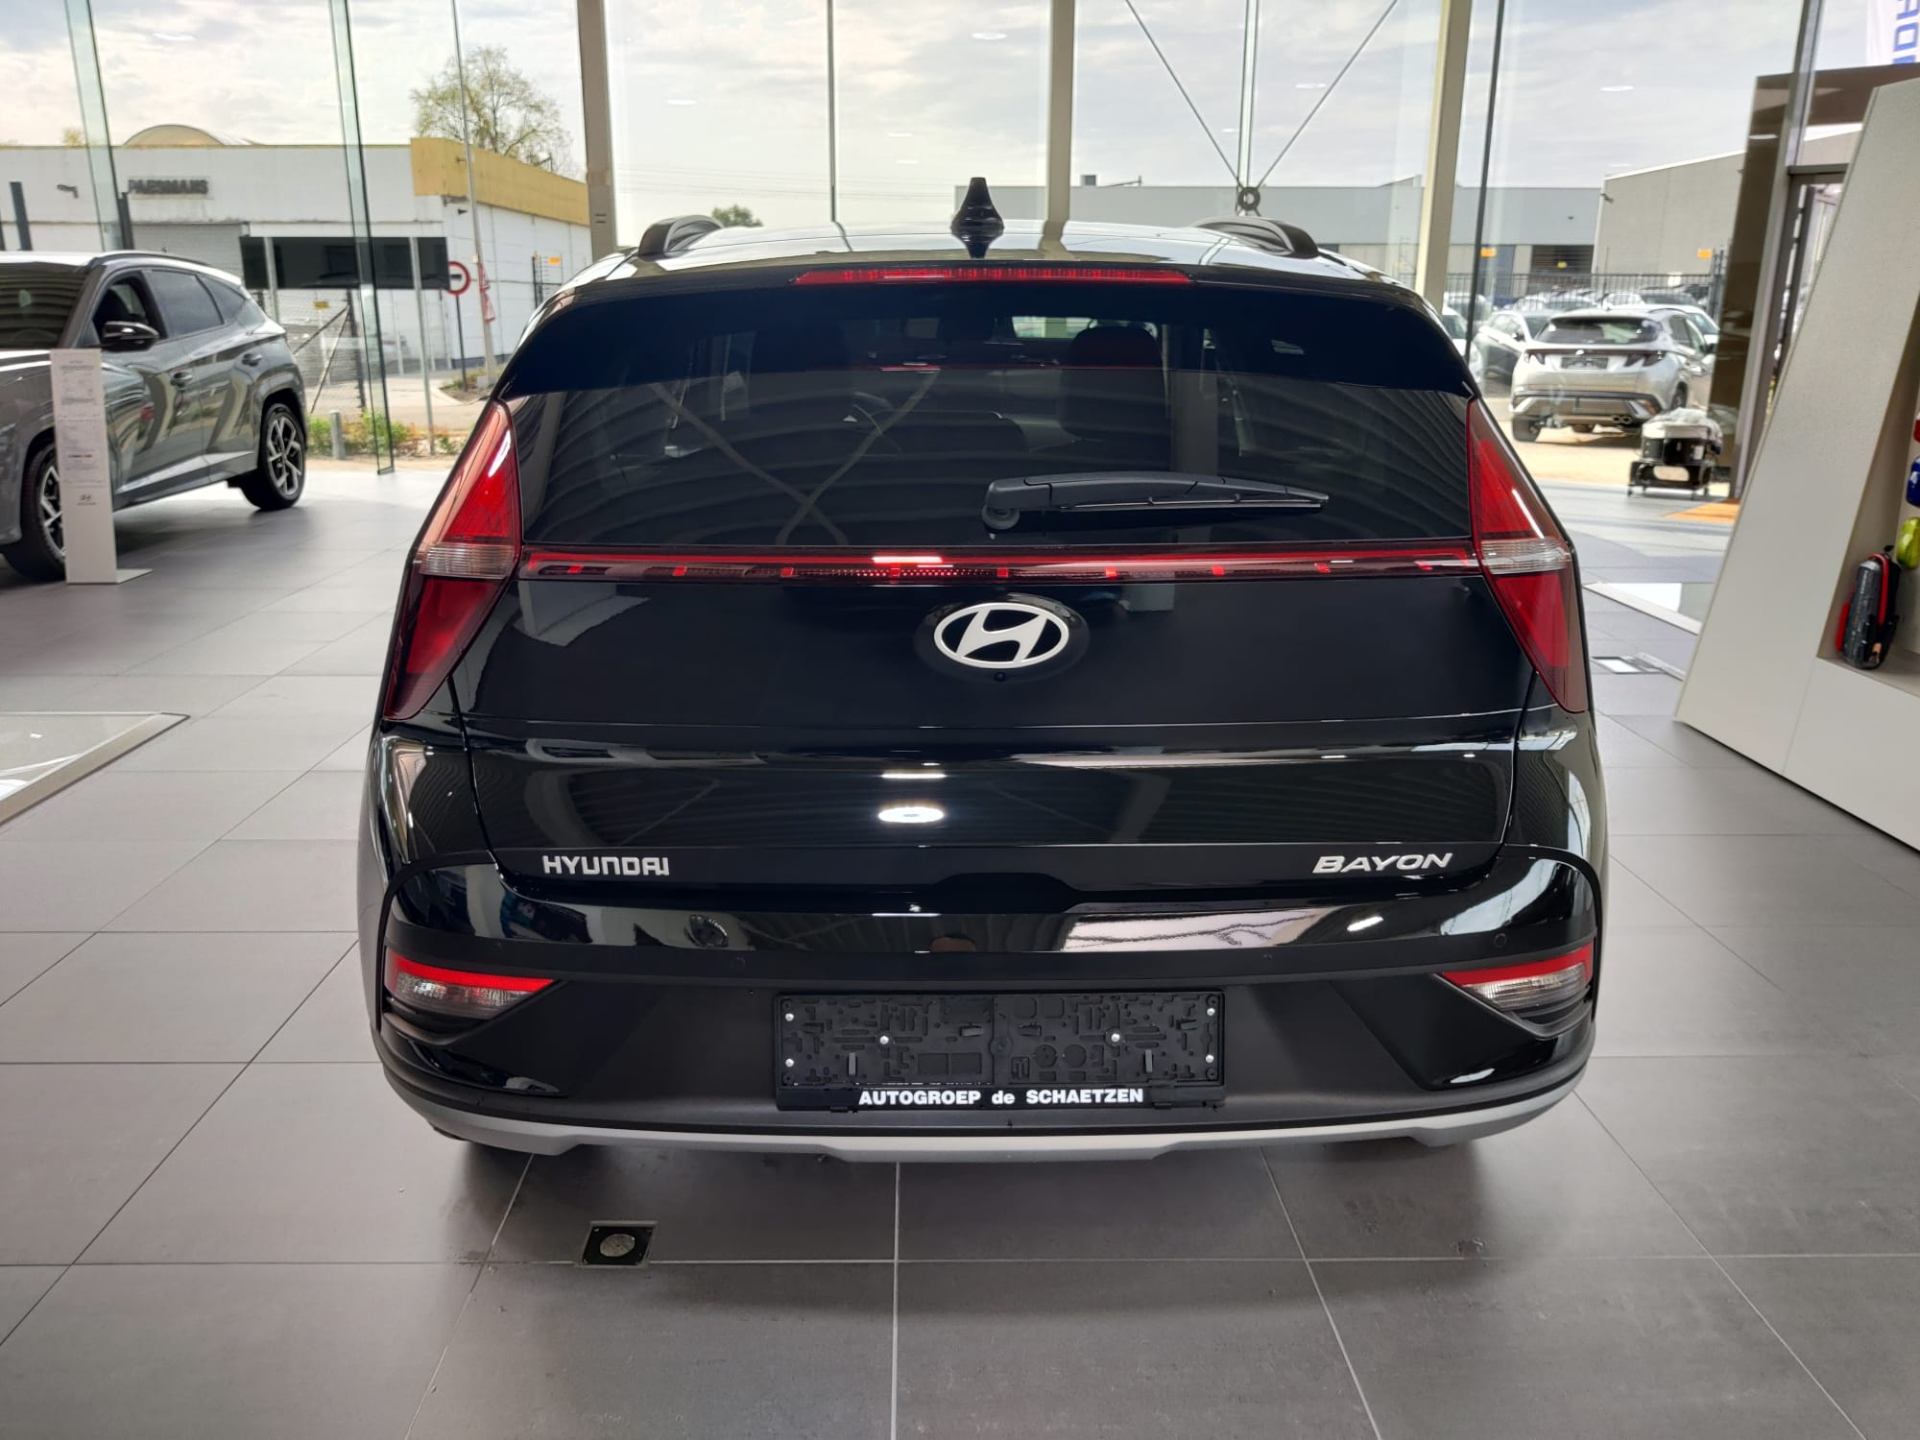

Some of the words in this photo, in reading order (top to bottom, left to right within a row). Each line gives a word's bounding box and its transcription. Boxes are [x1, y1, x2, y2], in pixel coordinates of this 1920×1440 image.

[542, 855, 670, 876] HYUNDAI
[1312, 852, 1454, 874] BAYON
[858, 1090, 981, 1105] AUTOGROEP
[991, 1090, 1016, 1105] de
[1026, 1088, 1144, 1104] SCHAETZEN
